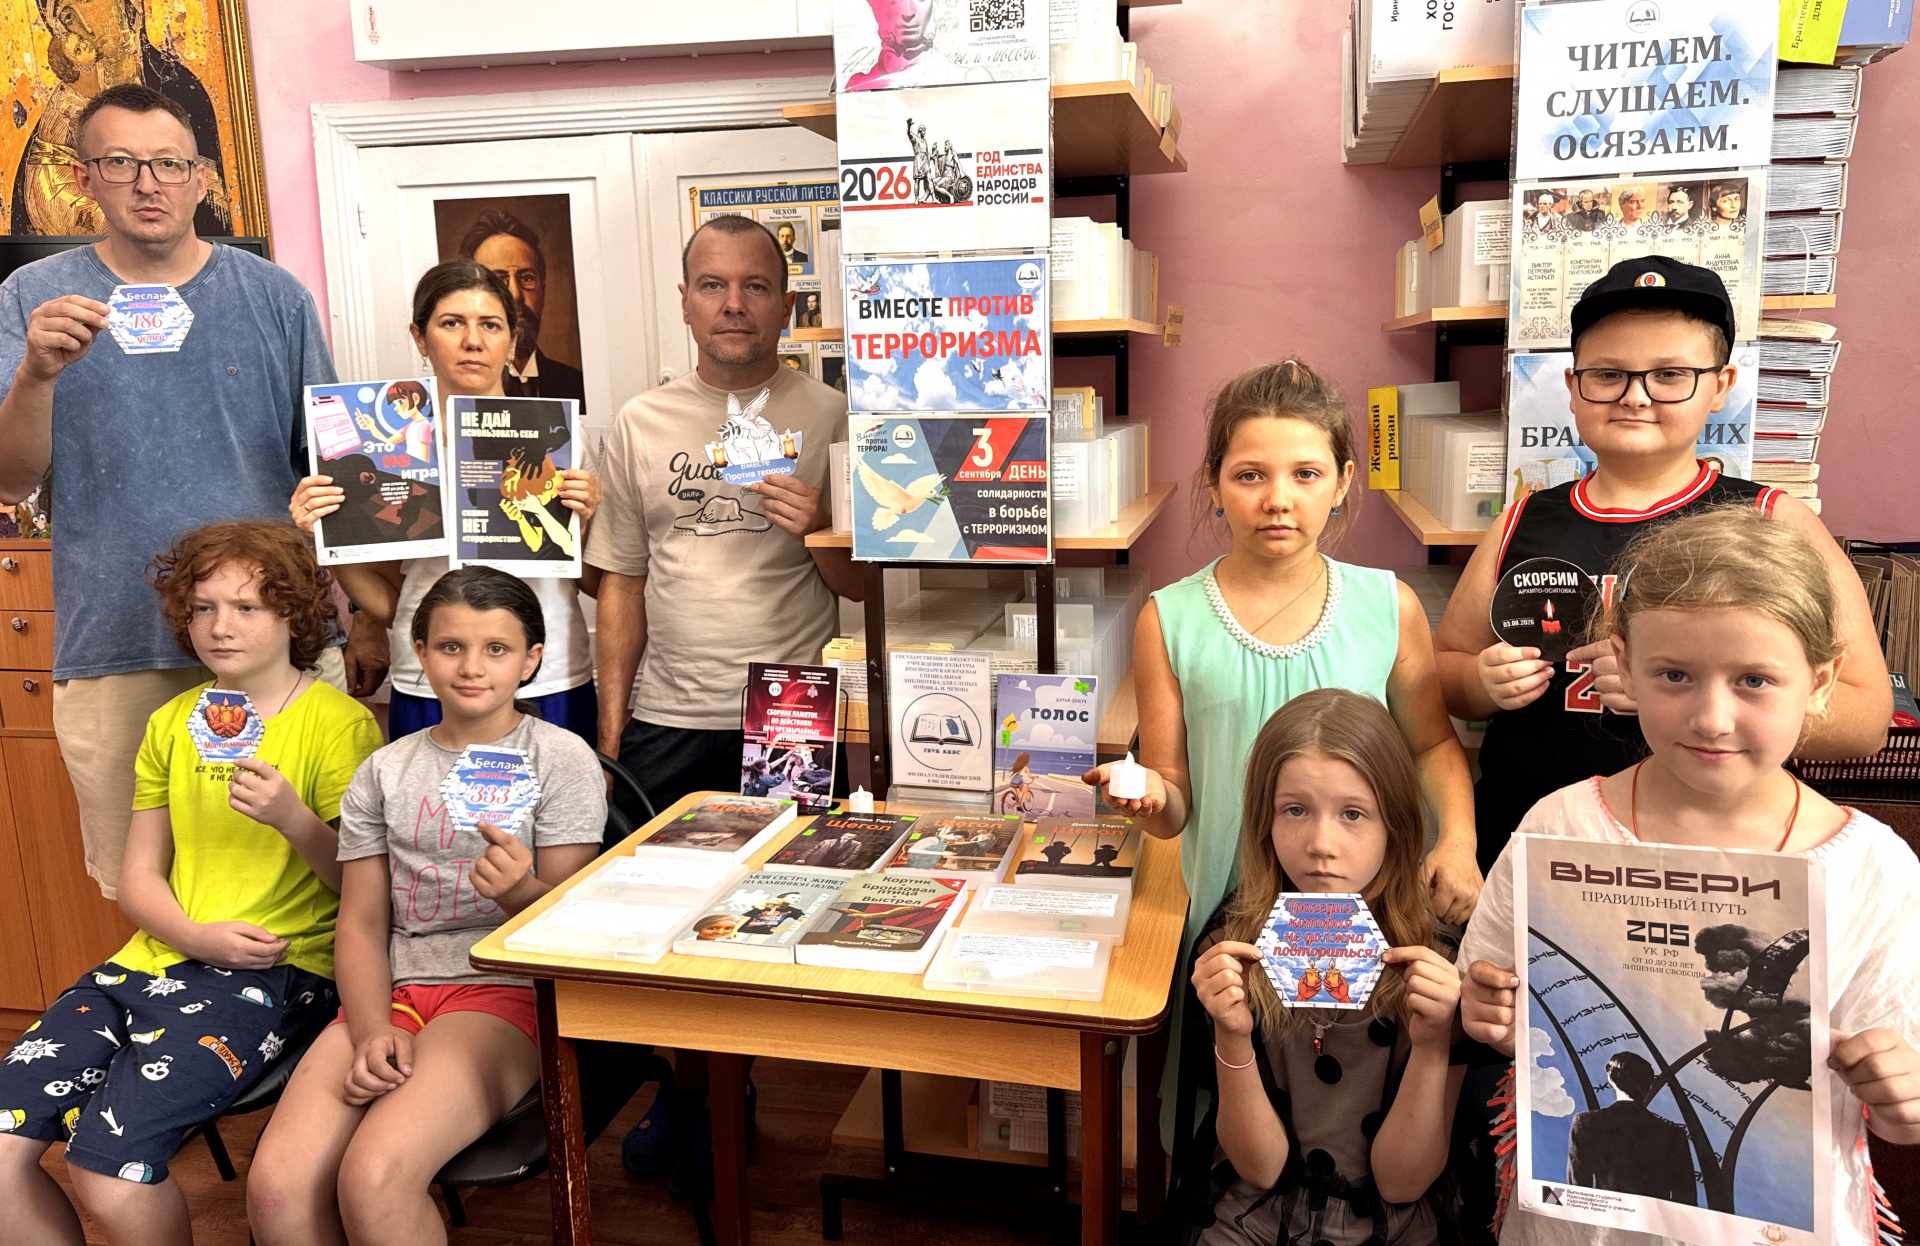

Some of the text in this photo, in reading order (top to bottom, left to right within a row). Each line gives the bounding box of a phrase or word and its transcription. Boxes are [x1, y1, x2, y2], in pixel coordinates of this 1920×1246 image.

[1567, 34, 1732, 72] ЧИТАЕМ.
[1546, 79, 1749, 118] СЛУШАЕМ.
[1553, 124, 1738, 161] ОСЯЗАЕМ.
[976, 150, 1001, 164] ГОД
[976, 163, 1043, 178] ЕДИНСТВА
[841, 165, 912, 202] 2026
[976, 177, 1037, 192] НАРОДОВ
[703, 190, 753, 206] КЛАССИКИ
[756, 186, 798, 203] РУССКОЙ
[977, 192, 1029, 206] РОССИИ
[773, 208, 797, 216] ЧЕХОВ
[126, 292, 166, 300] Беслан
[859, 294, 1034, 319] ВМЕСТЕ ПРОТИВ
[134, 313, 163, 329] 186
[851, 329, 1042, 360] ТЕРРОРИЗМА
[461, 410, 511, 429] НЕ ДАЙ
[461, 429, 539, 439] ИСПОЛЬЗОВАТЬ СЕБЯ
[855, 429, 887, 442] Вместе
[1371, 404, 1381, 473] Женский
[1387, 414, 1399, 461] роман
[362, 441, 395, 454] Это
[856, 445, 888, 453] ТЕРРОРА!
[865, 438, 888, 446] против
[971, 427, 994, 468] 3
[383, 455, 411, 468] не
[401, 467, 439, 482] игра
[725, 471, 756, 482] Против
[959, 469, 1001, 481] сентября
[1008, 464, 1047, 481] ДЕНЬ
[977, 489, 1047, 500] солидарности
[989, 504, 1047, 521] в борьбе
[462, 518, 489, 534] НЕТ
[963, 523, 1047, 535] с ТЕРРОРИЗМОМ
[1513, 571, 1579, 588] СКОРБИМ
[895, 654, 948, 662] ГОСУДАРСТВЕННОЕ
[906, 660, 944, 668] УЧРЕЖДЕНИЕ
[905, 666, 951, 674] КРАСНОДАРСКАЯ
[766, 708, 818, 718] СБОРНИК ПАМЯТОК
[780, 718, 812, 726] ДЕЙСТВИЯМ
[774, 726, 820, 735] ЧРЕЗВЫЧАЙНЫХ
[475, 758, 520, 770] Беслан
[470, 784, 510, 804] 333
[704, 803, 771, 815] Щегол
[825, 819, 894, 832] Щегол
[933, 819, 1004, 829] Щегол
[1052, 826, 1124, 837] Щегол
[810, 878, 846, 886] ЖИВЕТ
[882, 875, 932, 886] Кортик
[1550, 860, 1781, 900] ВЫБЕРИ
[861, 883, 937, 894] Бронзовая
[877, 889, 918, 897] птица
[862, 895, 922, 906] Выстрел
[1581, 890, 1747, 916] ПРАВИЛЬНЫЙ ПУТЬ
[1288, 898, 1356, 918] Трагедия,
[1288, 917, 1355, 931] которая
[1284, 932, 1366, 945] не должна
[1626, 919, 1690, 947] 205
[1273, 945, 1380, 960] повториться!
[1642, 946, 1680, 958] УК РФ
[1622, 963, 1706, 978] ЛИШЕНИЯ СВОБОДЫ
[1655, 959, 1667, 967] ДО
[1668, 960, 1678, 968] 20
[1679, 962, 1694, 970] ЛЕТ
[1538, 974, 1589, 998] ЖИЗНЬ
[1561, 1002, 1616, 1028] ЖИЗНЬ
[1577, 1032, 1640, 1057] ЖИЗНЬ
